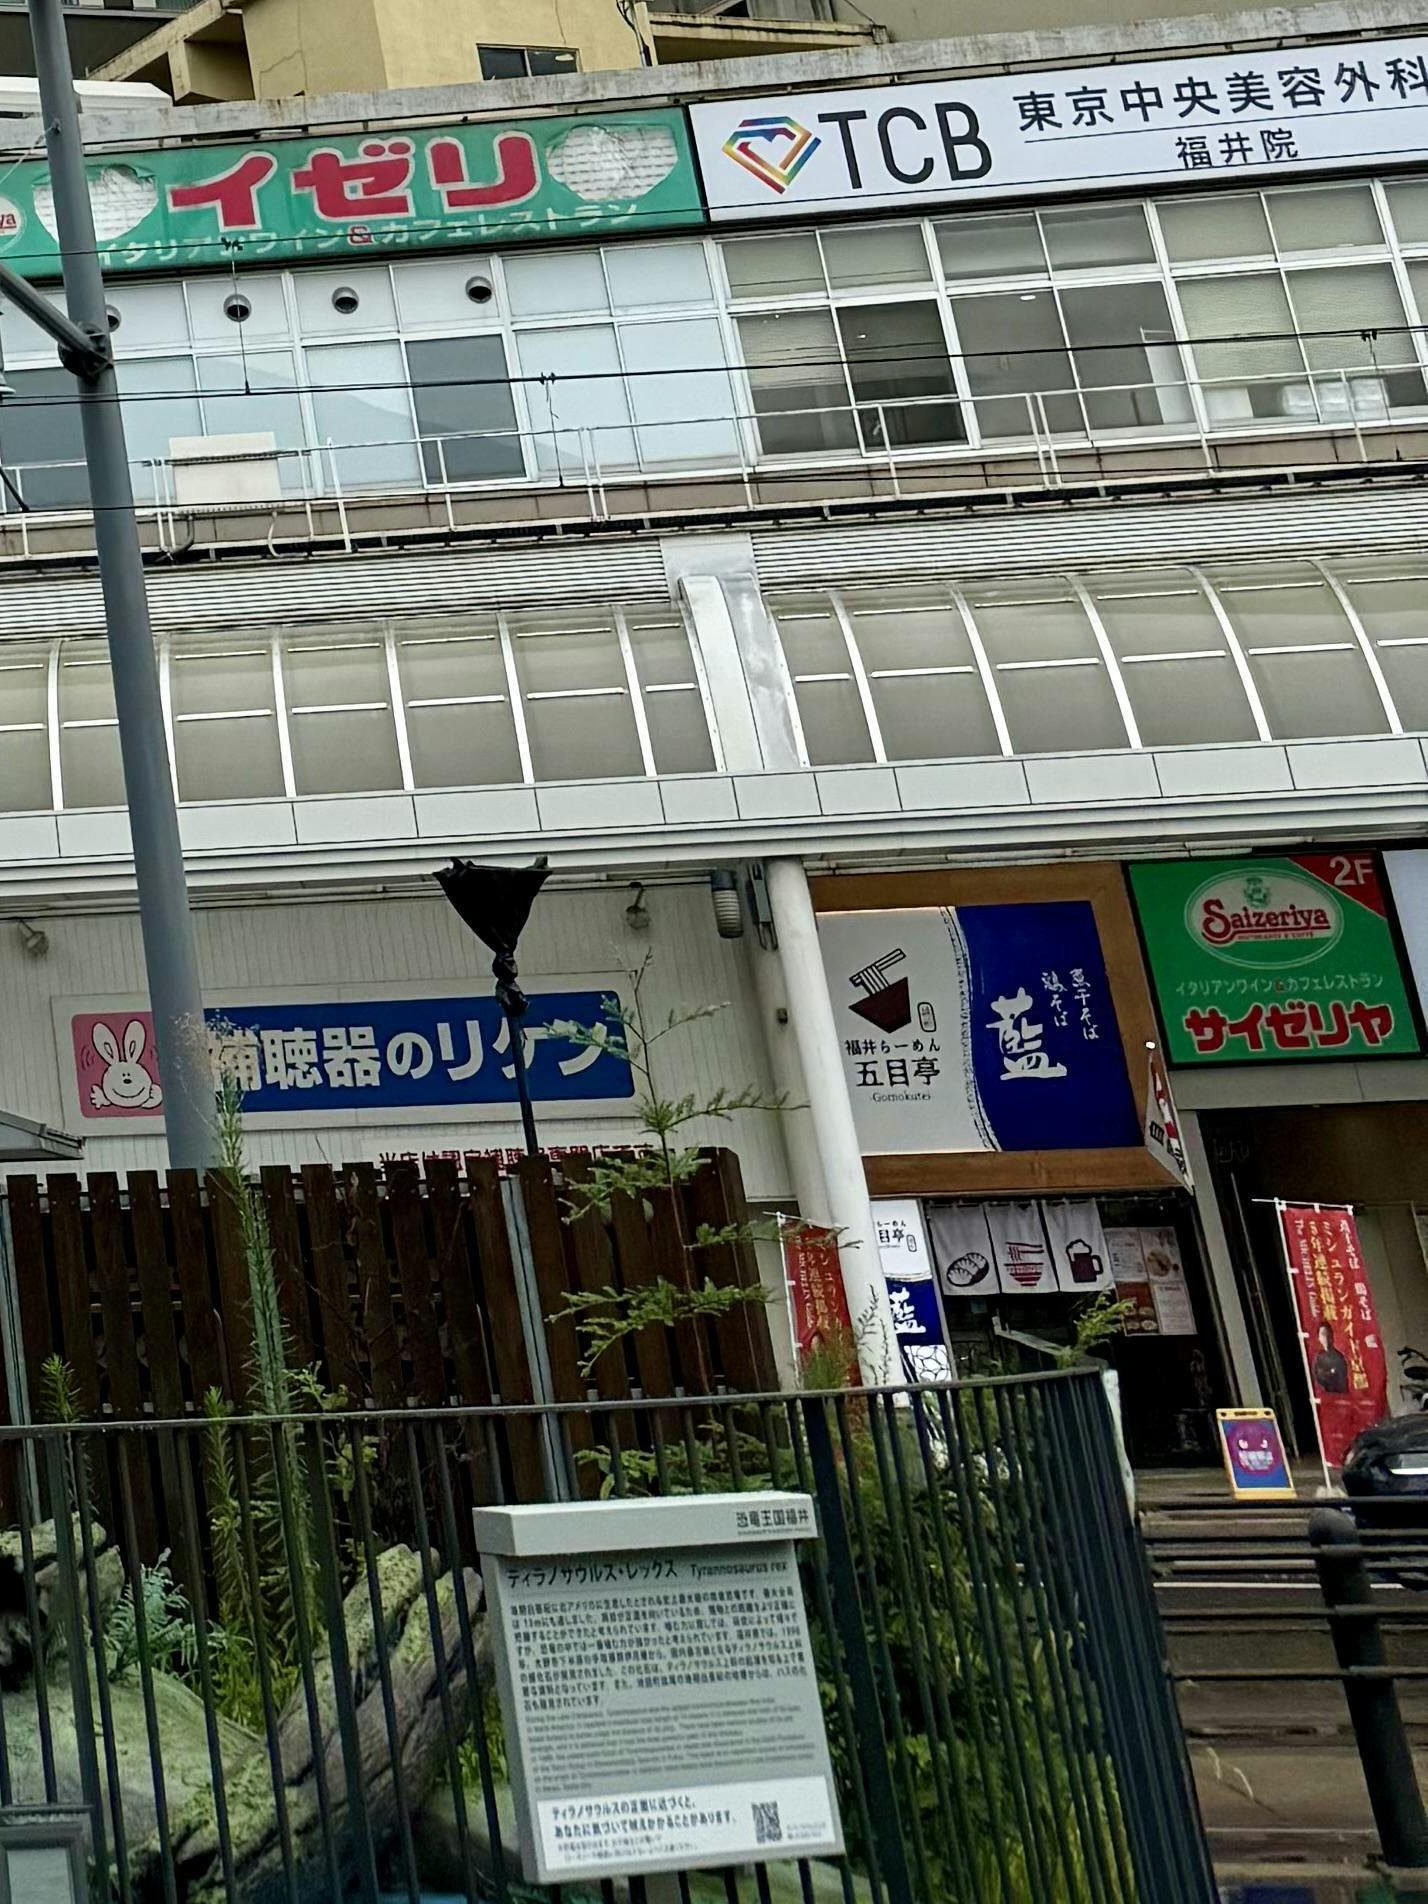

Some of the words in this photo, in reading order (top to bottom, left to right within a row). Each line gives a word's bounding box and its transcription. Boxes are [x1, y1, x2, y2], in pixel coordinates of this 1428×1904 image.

[1013, 57, 1428, 132] 東京中央美容外科
[818, 102, 992, 190] TCB
[1176, 129, 1299, 170] 福井院
[1329, 857, 1373, 886] 2F
[1202, 898, 1331, 944] Saizeriya
[845, 1038, 941, 1056] 福井らーめん
[986, 987, 1067, 1080] 藍
[1183, 999, 1394, 1053] サイゼリヤ
[208, 1015, 609, 1092] 補聴器のリケン
[855, 1056, 941, 1088] 五目亭
[691, 1563, 768, 1581] Tyrannosaurus
